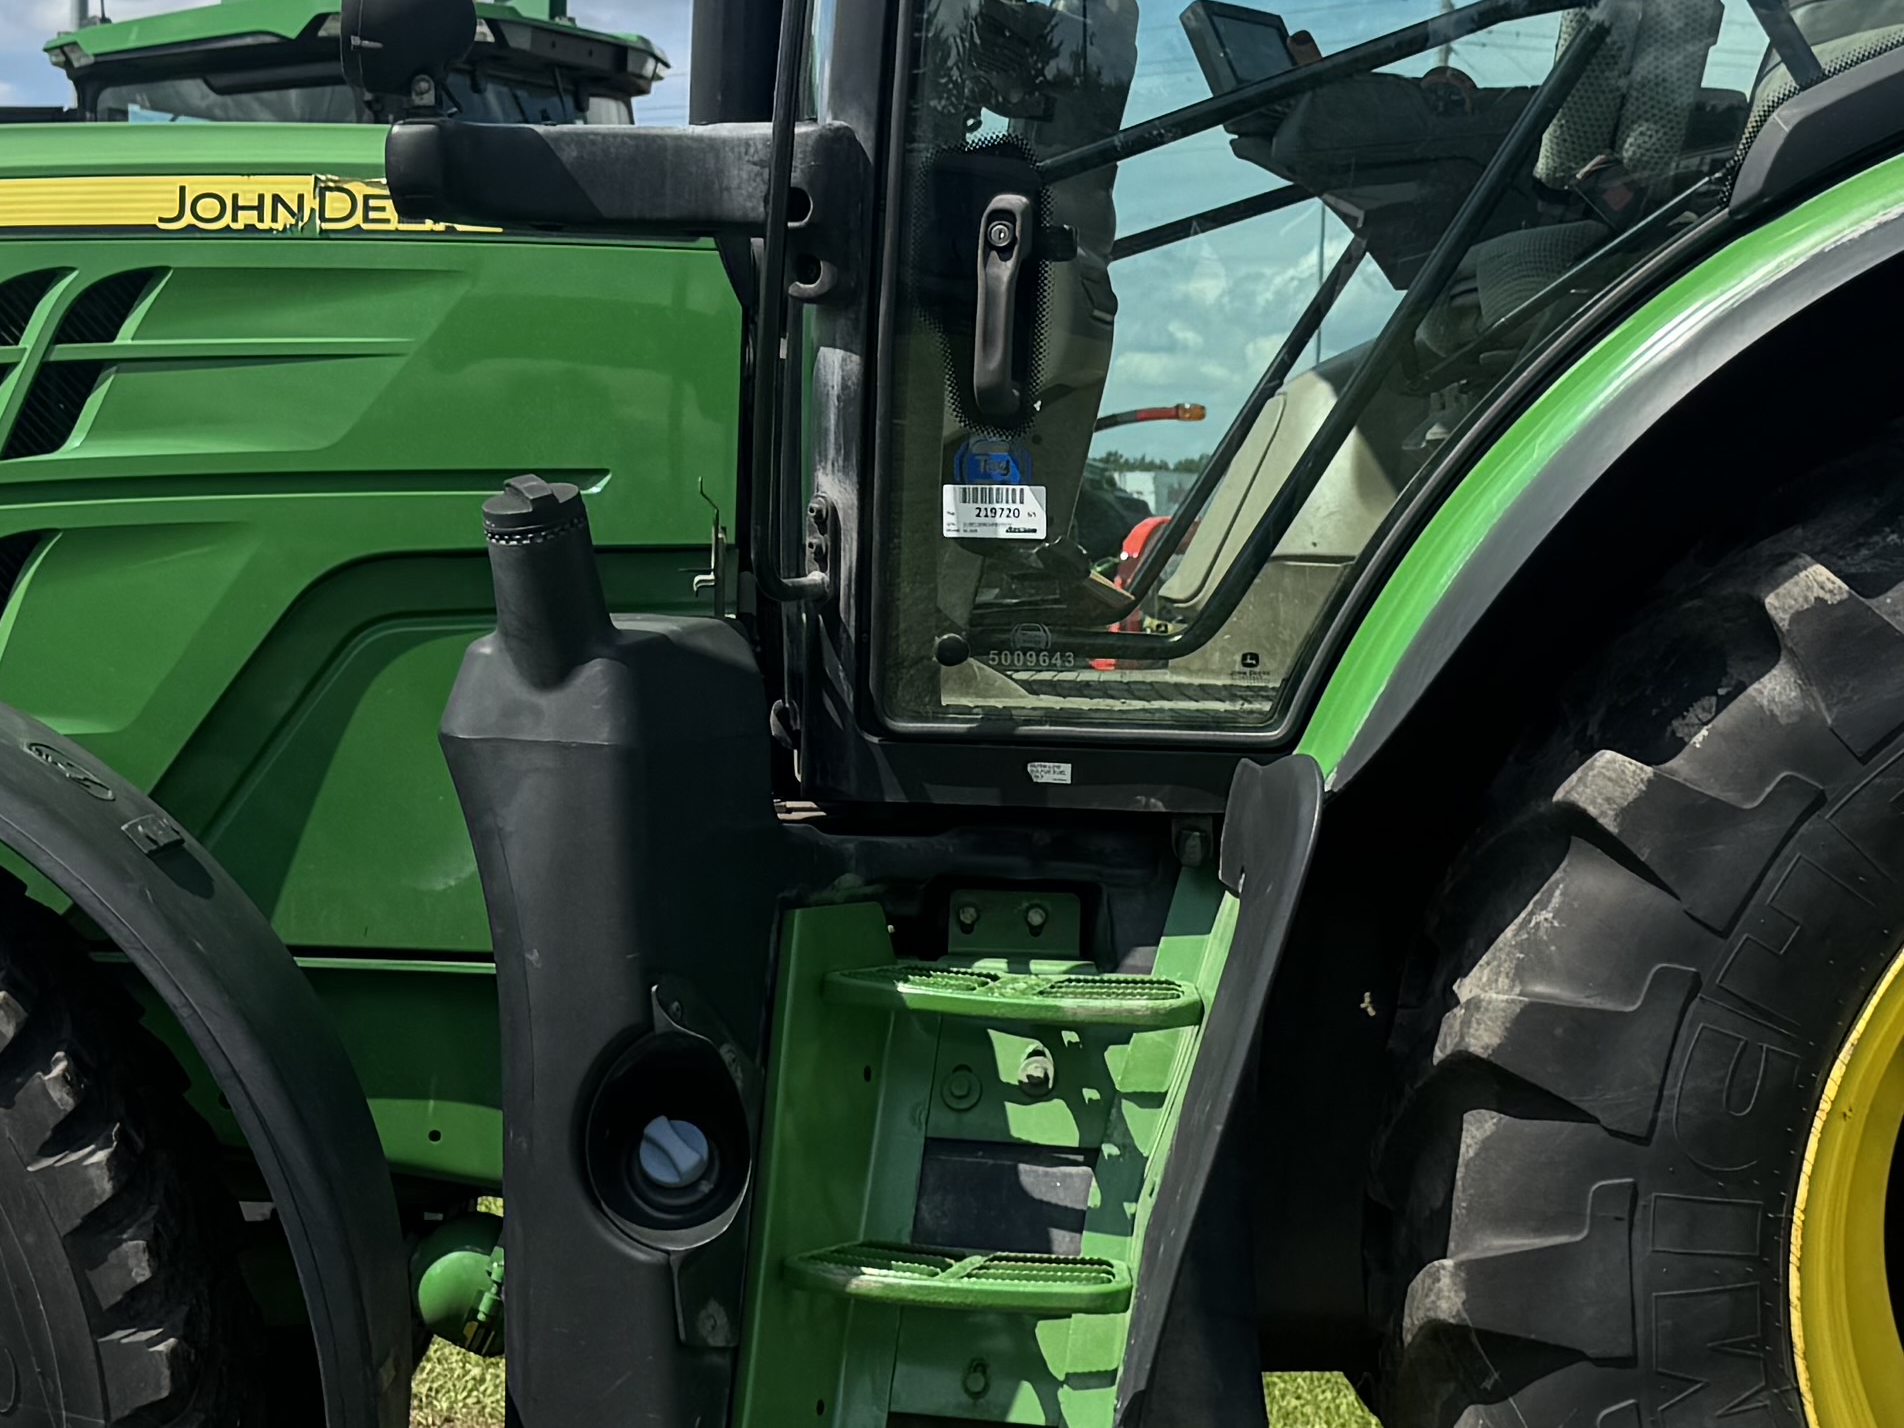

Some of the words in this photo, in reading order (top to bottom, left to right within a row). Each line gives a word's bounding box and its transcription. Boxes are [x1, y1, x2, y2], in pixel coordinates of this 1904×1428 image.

[157, 185, 305, 224] JOHN
[975, 507, 1021, 518] 219720
[988, 650, 1075, 668] 5009643
